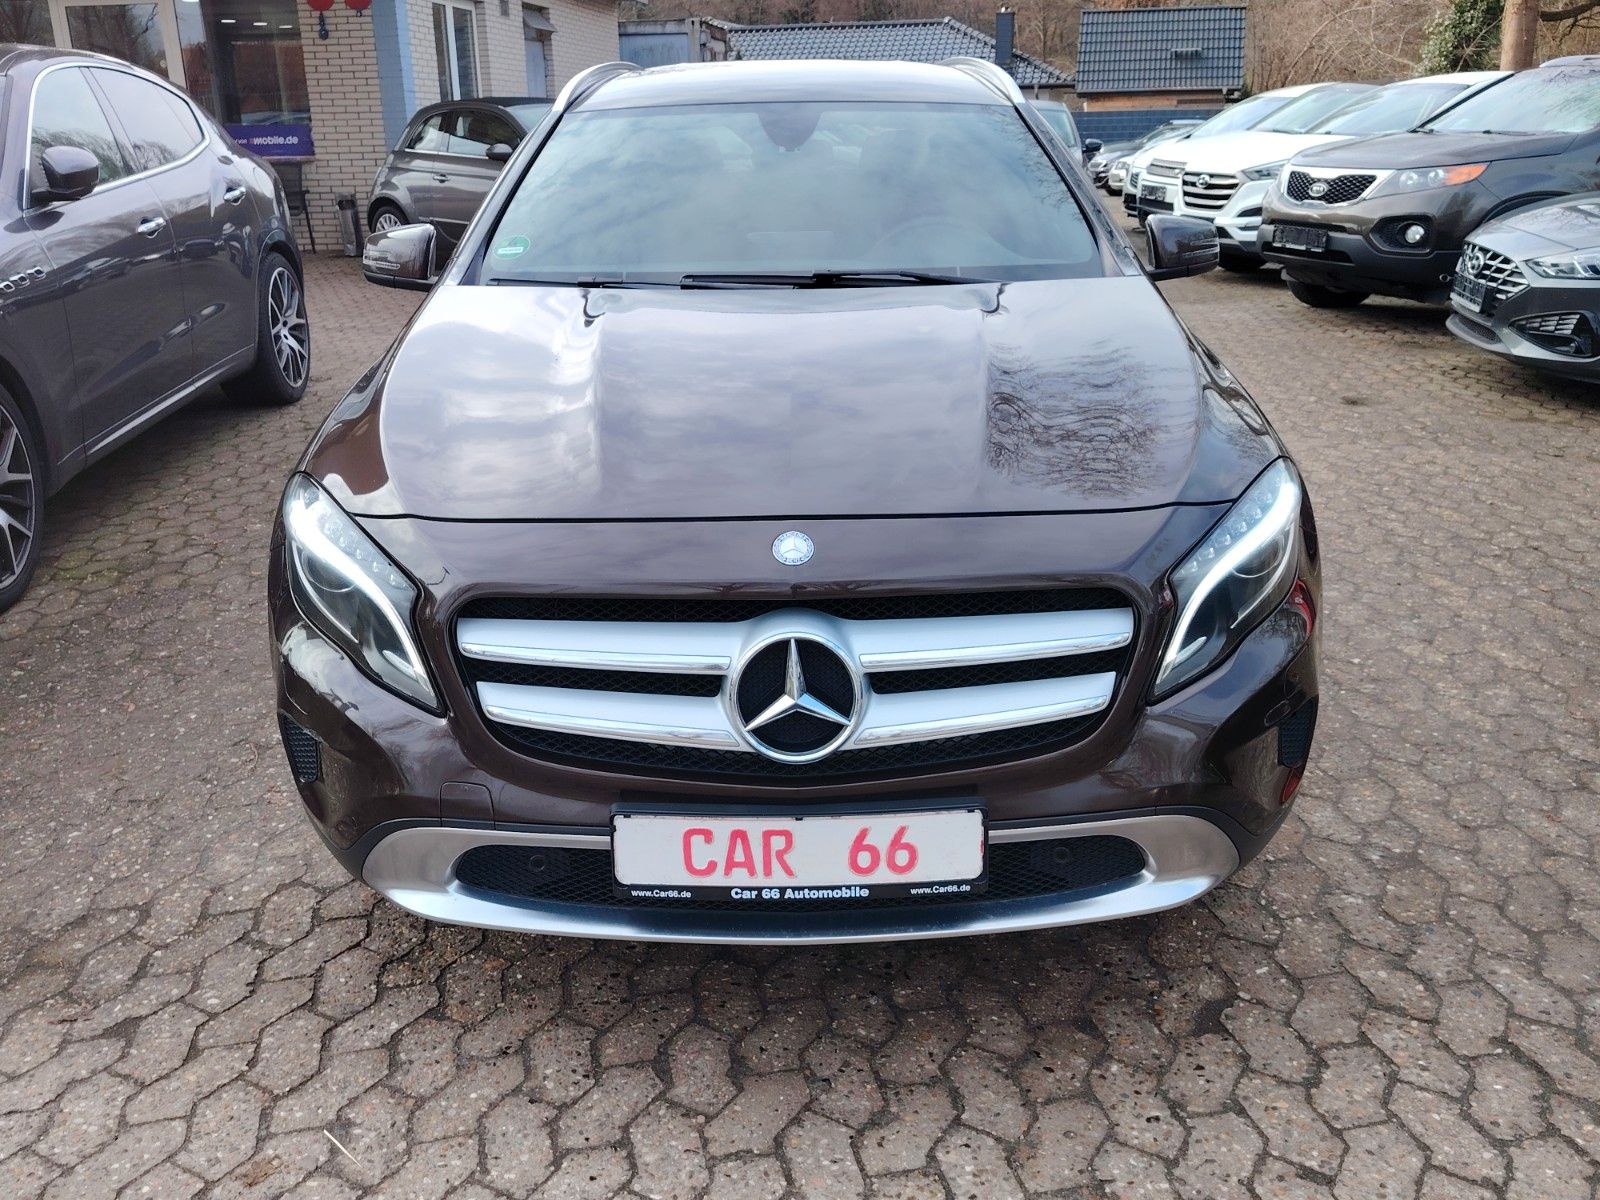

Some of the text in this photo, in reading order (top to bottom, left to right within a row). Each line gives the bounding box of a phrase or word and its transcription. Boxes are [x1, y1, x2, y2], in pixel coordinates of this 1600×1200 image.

[253, 136, 299, 145] mobile.de
[682, 823, 919, 879] CAR 66
[631, 889, 692, 899] www.Car66.de
[730, 886, 870, 899] Car 66 Automobile
[910, 884, 971, 895] www.Car66.de
